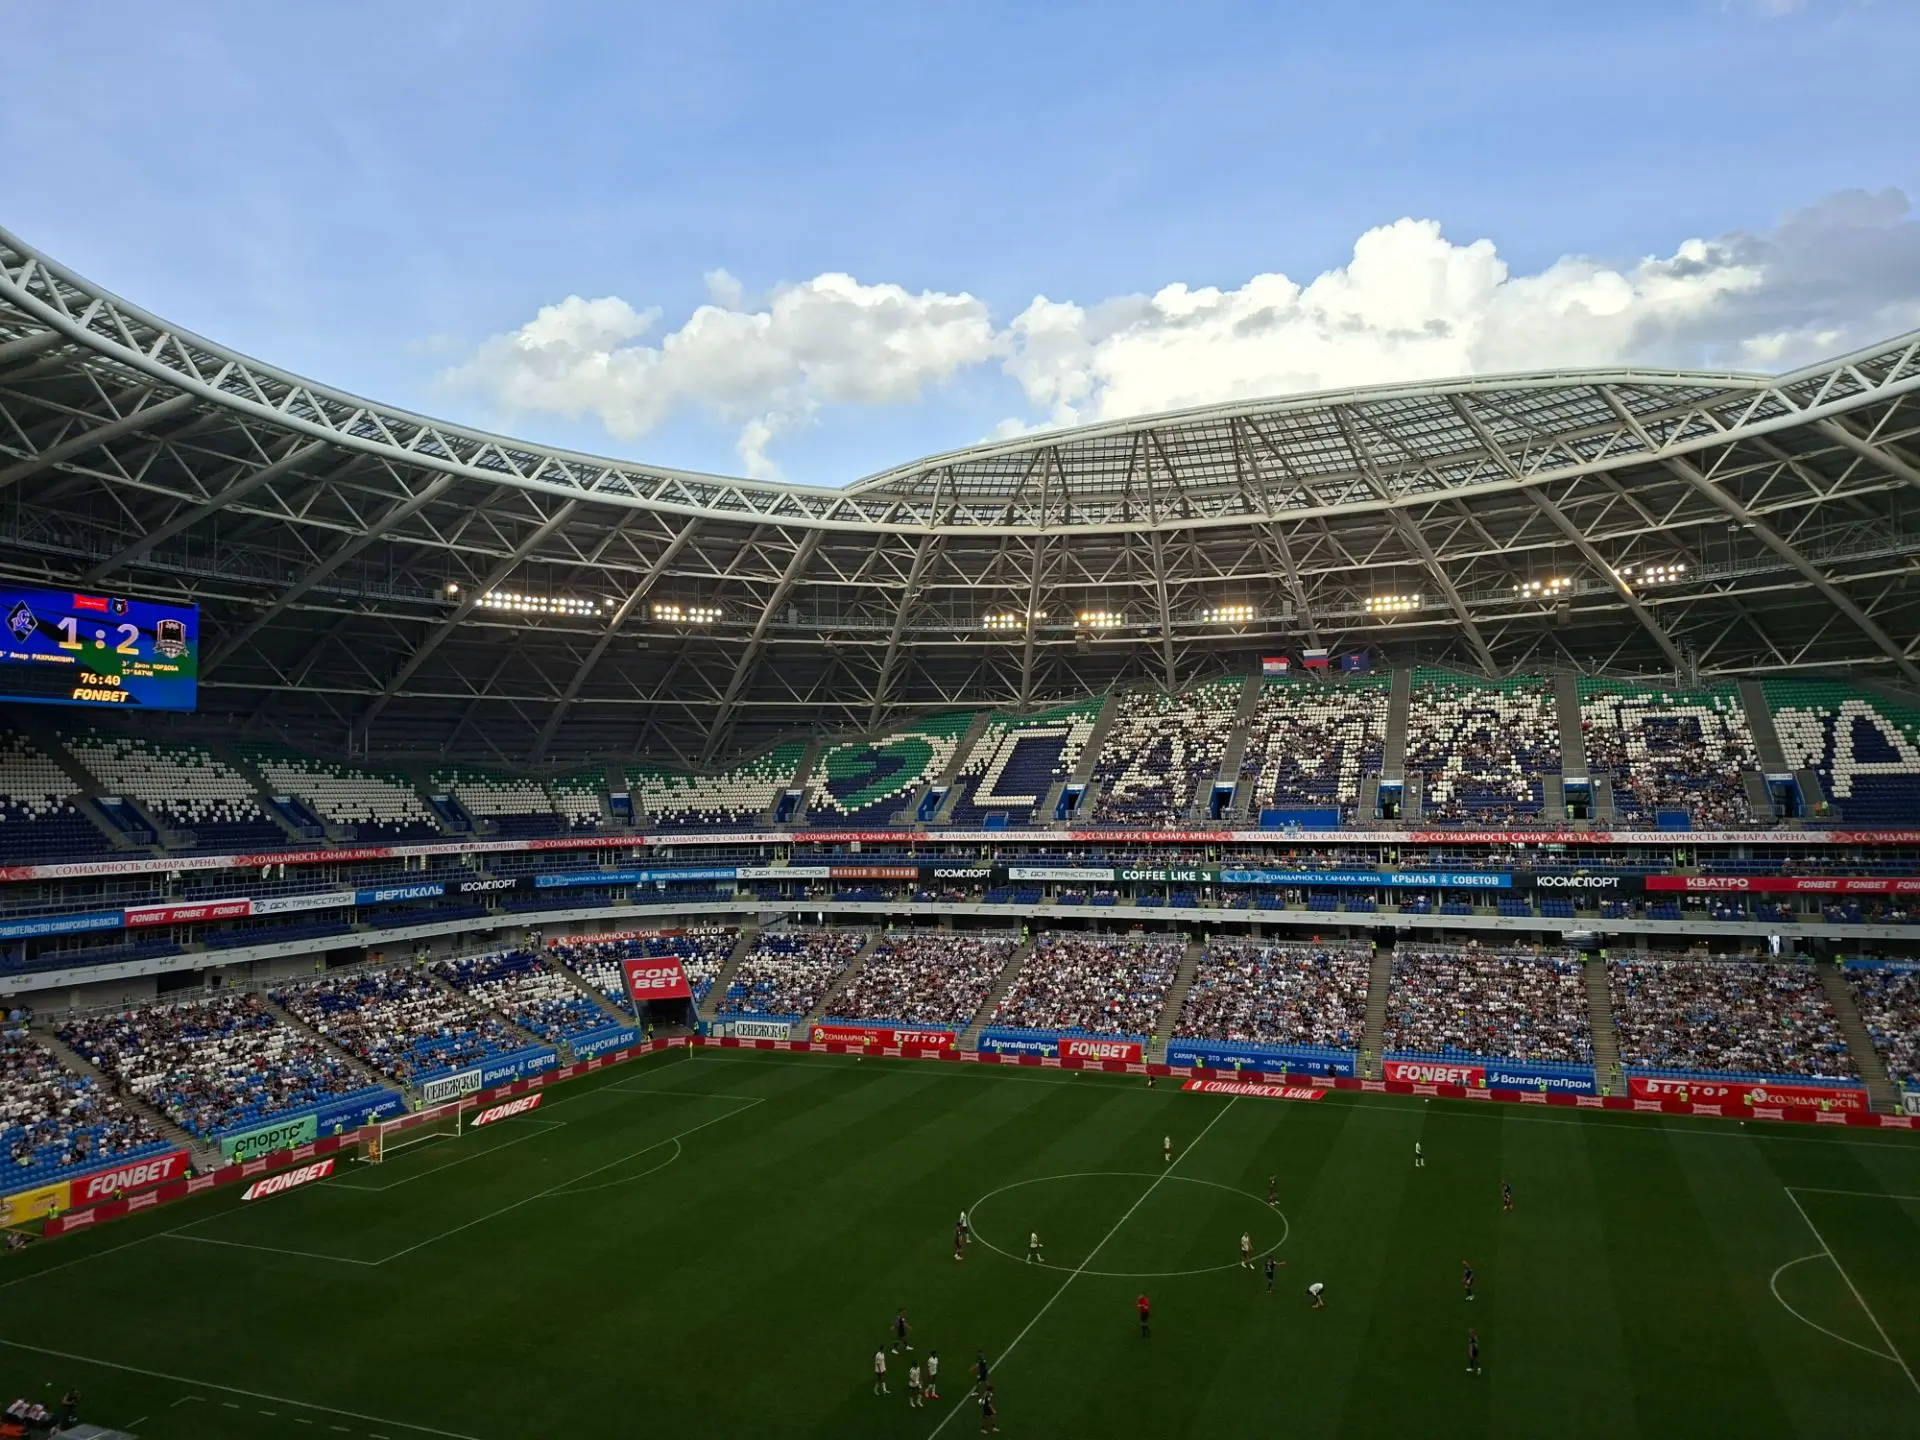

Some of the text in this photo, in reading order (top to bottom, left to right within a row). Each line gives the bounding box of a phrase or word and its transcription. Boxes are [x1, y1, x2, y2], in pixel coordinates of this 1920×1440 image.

[57, 617, 83, 650] 1
[116, 623, 140, 656] 2
[80, 672, 121, 686] 76:40
[73, 688, 129, 702] FONBET
[545, 837, 641, 848] СОЛИДАРНОСТЬ САМАРА
[806, 833, 859, 841] СОЛИДАРНОСТЬ
[1152, 832, 1187, 840] САМАРА
[1189, 832, 1215, 840] АРЕНА
[1248, 832, 1391, 840] СОЛИДАОСТЬ САМАРА АРЕНА
[1429, 833, 1508, 841] СОЛИДАРНОСТЬ
[1631, 833, 1807, 841] СОЛИДАРНОСТЬ САМАРА АРЕНА
[404, 844, 458, 854] СОЛИДАРНОСТЬ
[253, 850, 377, 864] СОЛИДАРНОСТЬ САМАРА АРЕНА
[55, 858, 217, 876] СОЛИДАРНОСТЬ САМАРА АРЕНА
[774, 868, 826, 876] ТРАНССТРОЙ
[1051, 870, 1109, 878] ТРАНССТРОЙ
[1122, 870, 1196, 881] COFFEE LIKE
[1266, 873, 1323, 881] СОЛИДАРНОСТЬ
[1325, 874, 1356, 882] САМАРА
[1391, 874, 1499, 885] КРЫЛЬЯ СОВЕТОВ
[1686, 877, 1749, 887] КВАТРО
[1797, 880, 1839, 889] FONBET
[1846, 881, 1889, 889] FONBET
[375, 886, 444, 901] ВЕРТИКАЛЬ
[292, 895, 352, 907] ТРАНССТРОЙ
[130, 905, 246, 923] FONBET FONBET FONBET
[50, 918, 90, 932] САМАРСКОЙ
[91, 916, 119, 928] ОБЛАСТИ
[571, 927, 725, 943] СОЛИДАРНОСТЬ БАНК СЕКТОР
[632, 967, 678, 979] FON
[634, 976, 682, 989] BET
[620, 1031, 634, 1045] БКК
[893, 1030, 946, 1044] БЕЛТОР
[1069, 1042, 1131, 1058] FONBET
[1173, 1052, 1197, 1060] САМАРА
[484, 1054, 556, 1082] КРЫЛЬЯ СОВЕТОВ
[1396, 1065, 1472, 1083] FONBET
[426, 1072, 480, 1101] СЕНЕЖСКАЯ
[1501, 1075, 1592, 1089] ВолгаАвтоПром
[1646, 1079, 1729, 1096] БЕЛТОР
[1204, 1081, 1315, 1099] СОЛИДАРНОСТЬ БАНК
[479, 1093, 543, 1124] FONBET
[86, 1157, 176, 1199] FONBET
[252, 1159, 335, 1198] FONBET
